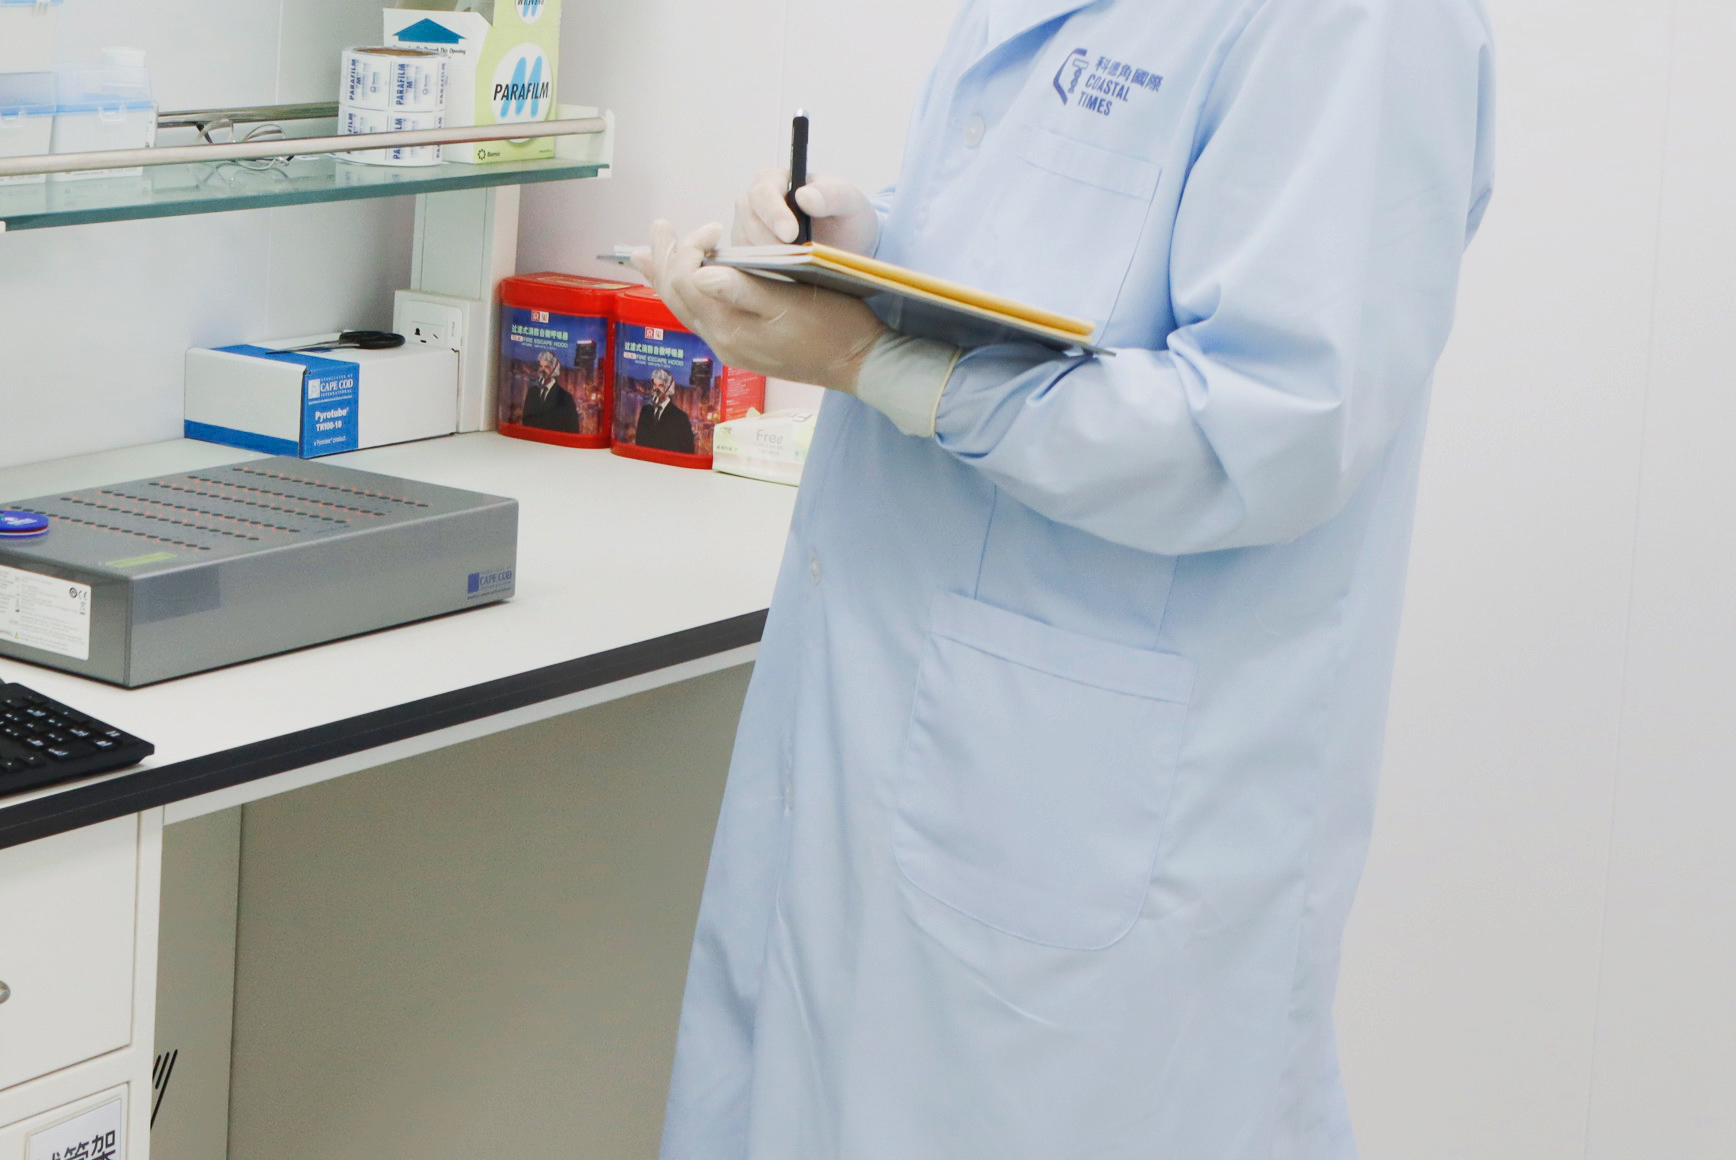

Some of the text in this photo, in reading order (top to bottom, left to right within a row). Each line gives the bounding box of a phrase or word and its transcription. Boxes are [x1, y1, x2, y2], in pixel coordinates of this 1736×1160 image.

[349, 59, 357, 100] PARAFILM
[396, 63, 406, 105] PARAFILM
[1085, 73, 1131, 102] COASTAL
[493, 81, 549, 101] PARAFILM
[1077, 91, 1113, 116] TIMES
[320, 379, 354, 392] CAPE COD
[316, 420, 342, 432] TK100-10
[756, 430, 784, 444] Free
